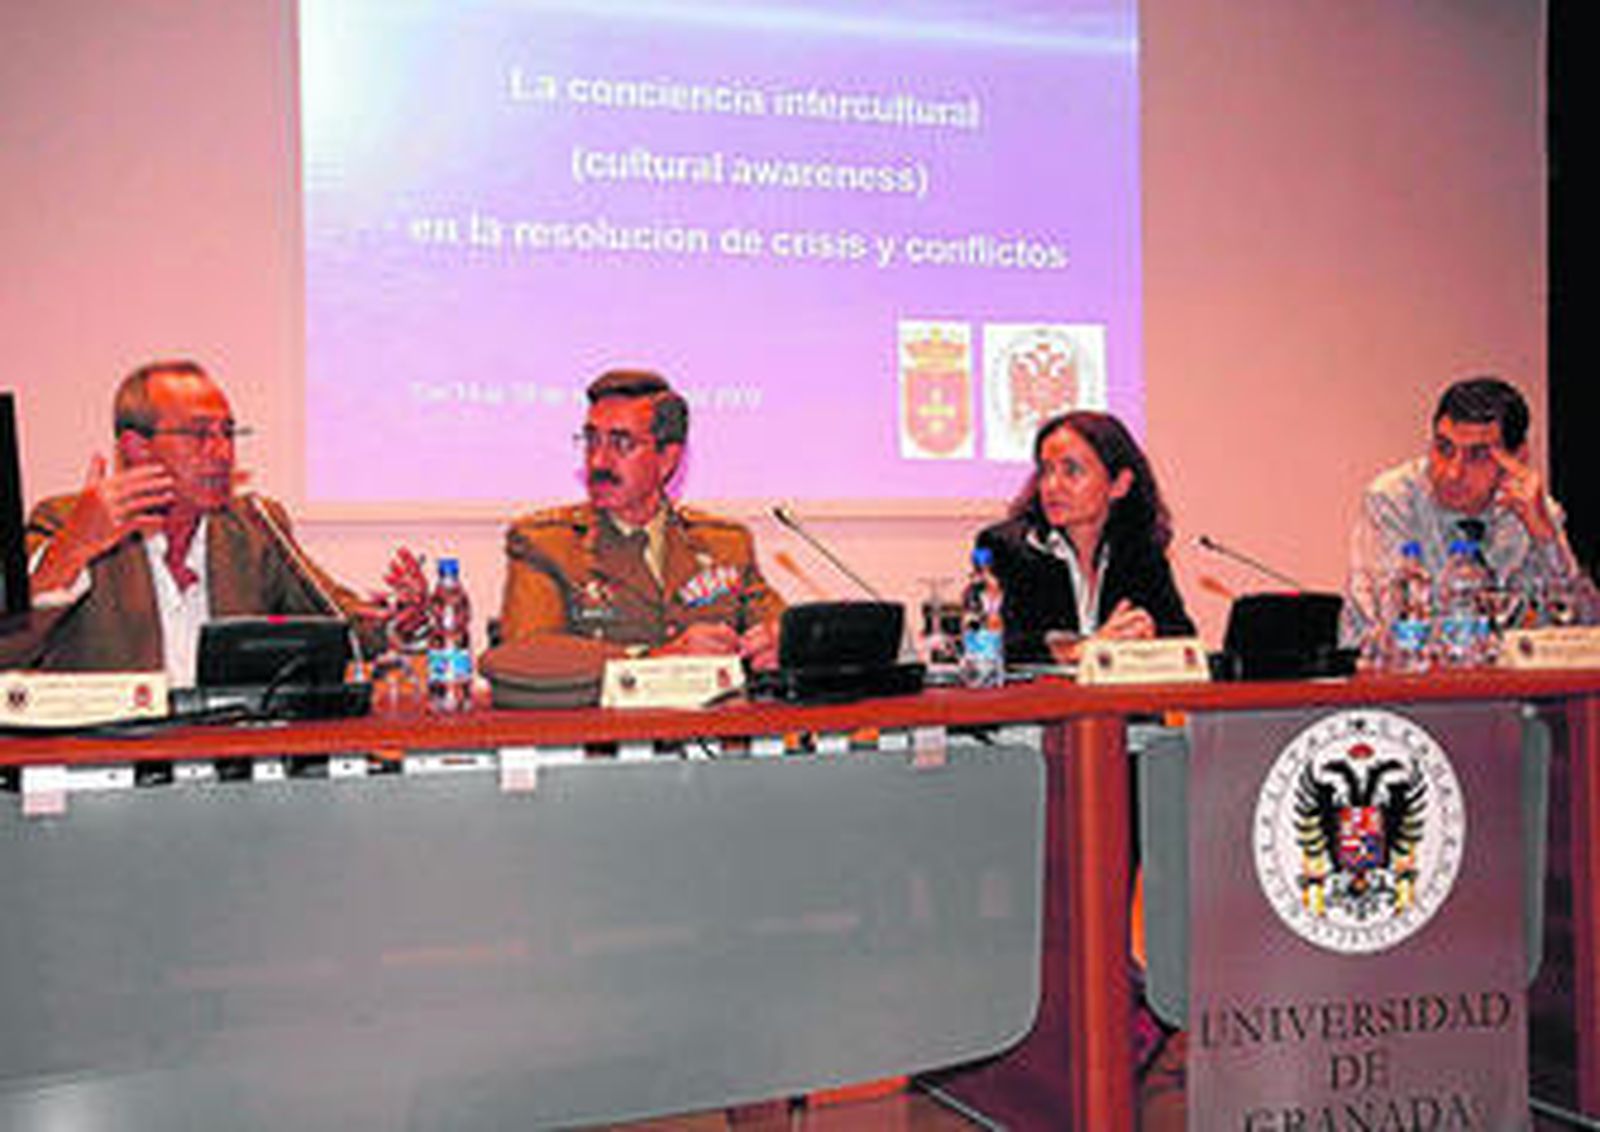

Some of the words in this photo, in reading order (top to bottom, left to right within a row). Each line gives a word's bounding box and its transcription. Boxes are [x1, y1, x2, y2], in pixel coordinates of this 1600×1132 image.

[508, 67, 556, 101] La
[566, 76, 766, 116] conciencia
[774, 88, 979, 129] intercultural
[571, 147, 724, 185] (cultural
[731, 155, 929, 200] awareness)
[411, 218, 458, 243] en
[470, 211, 501, 245] la
[720, 229, 763, 255] de
[771, 231, 867, 260] crisis
[876, 236, 896, 268] y
[905, 234, 1069, 270] conflictos
[1201, 992, 1512, 1050] UNIVERSIDAD
[1329, 1051, 1389, 1091] DE
